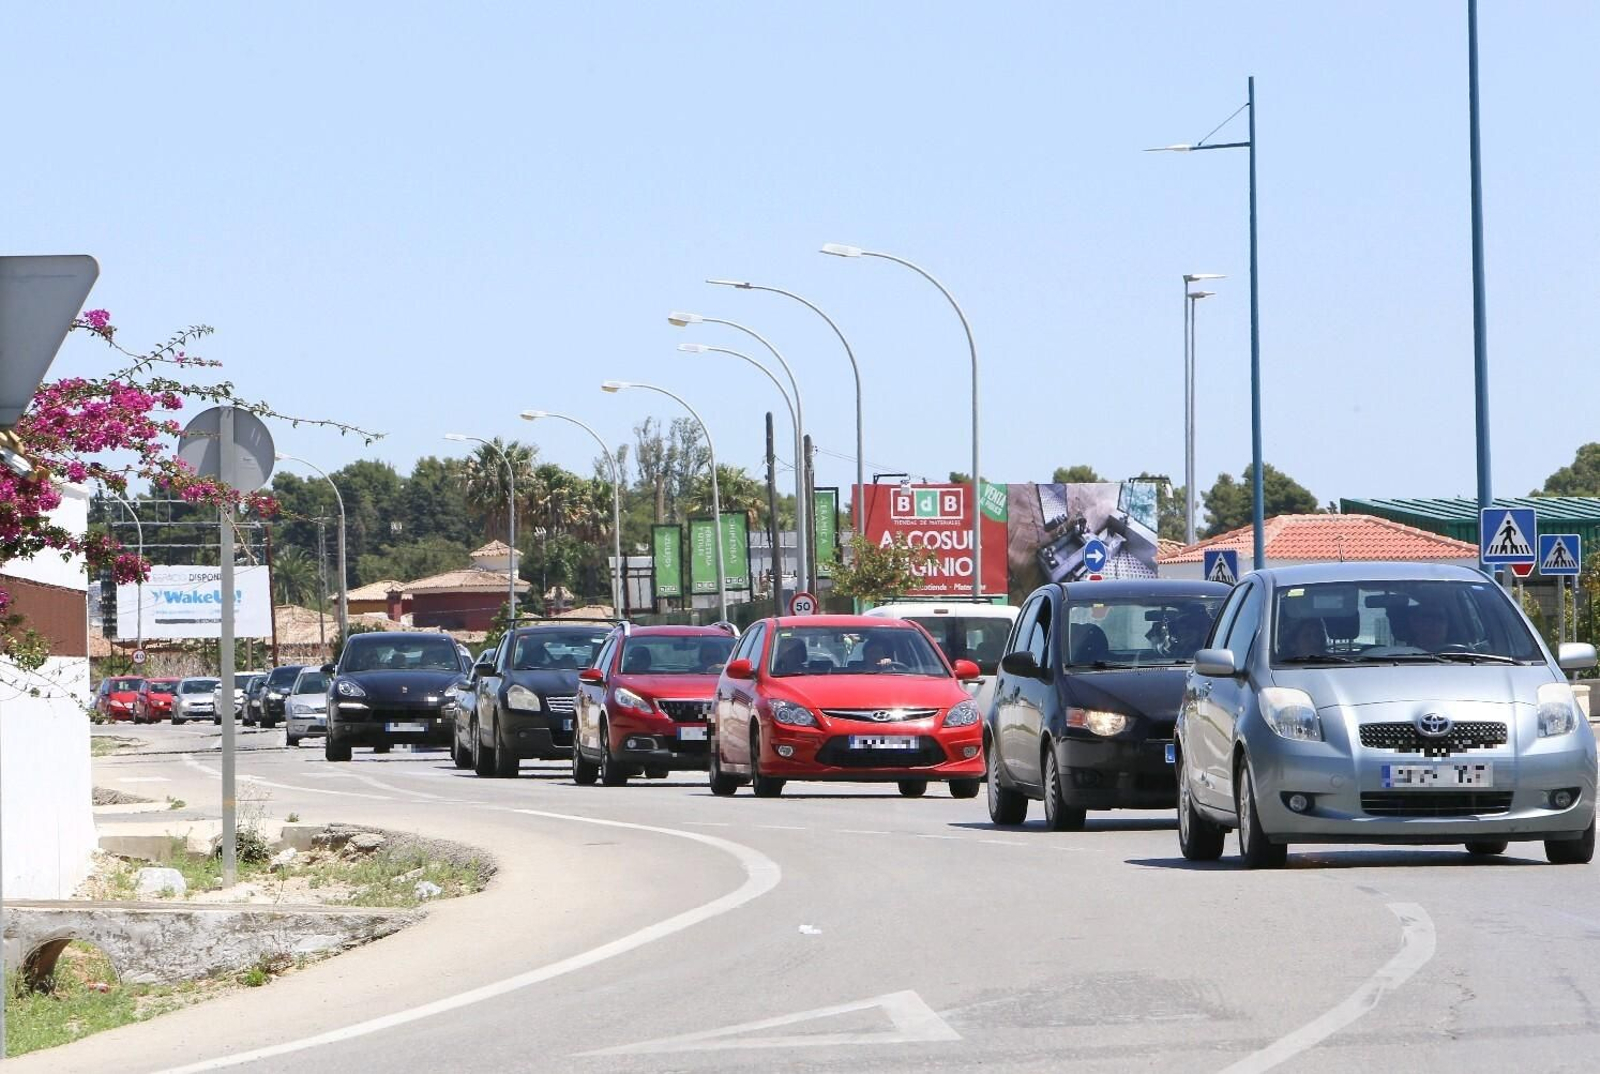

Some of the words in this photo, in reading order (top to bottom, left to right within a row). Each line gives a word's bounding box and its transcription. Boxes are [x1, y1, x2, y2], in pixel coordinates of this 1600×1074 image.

[985, 484, 1006, 508] VENTA
[796, 602, 811, 612] 50
[134, 652, 144, 660] 40
